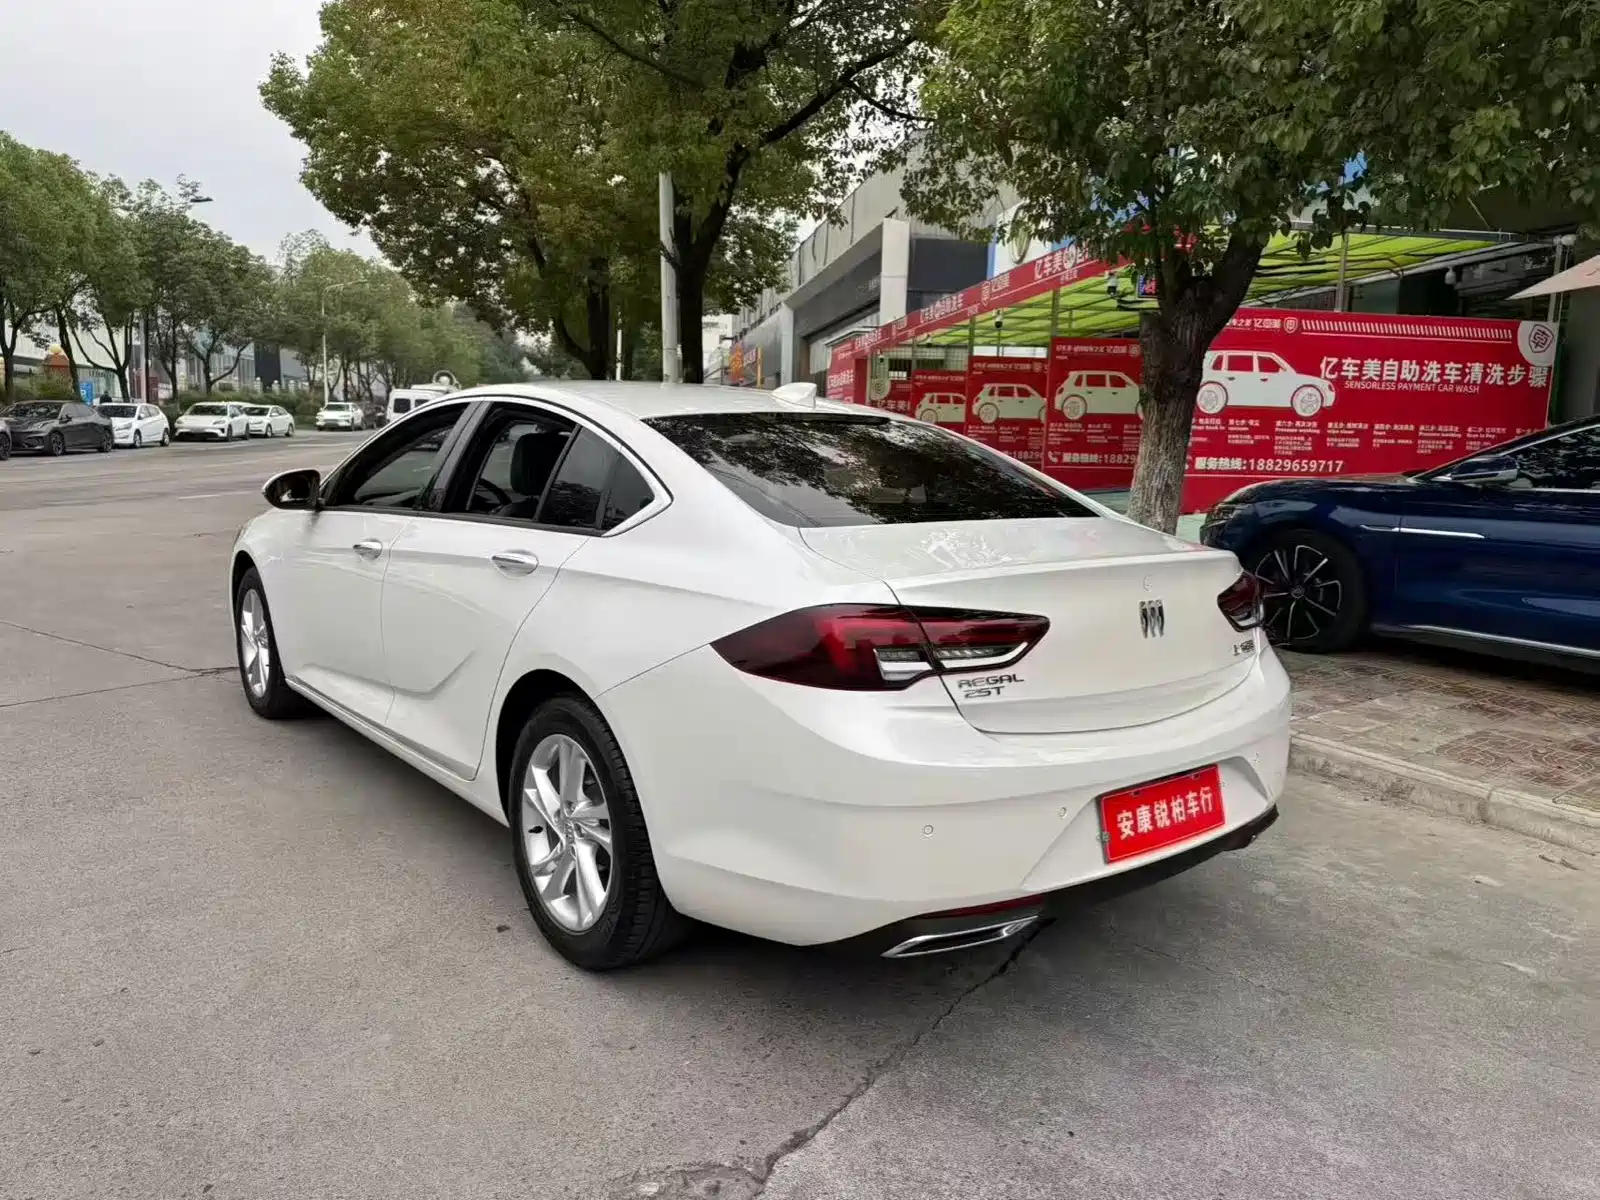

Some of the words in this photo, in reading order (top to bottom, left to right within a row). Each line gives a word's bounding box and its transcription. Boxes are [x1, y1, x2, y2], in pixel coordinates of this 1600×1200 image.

[1319, 356, 1549, 388] 亿车美自助洗车清洗步骤
[1344, 381, 1397, 391] SENSORLESS
[1397, 382, 1437, 392] PAYMENT
[1437, 384, 1454, 393] CAR
[1455, 384, 1480, 394] WASH
[958, 674, 1025, 688] REGAL
[963, 686, 1005, 699] 25T
[1116, 786, 1213, 840] 安康锐柏车行
